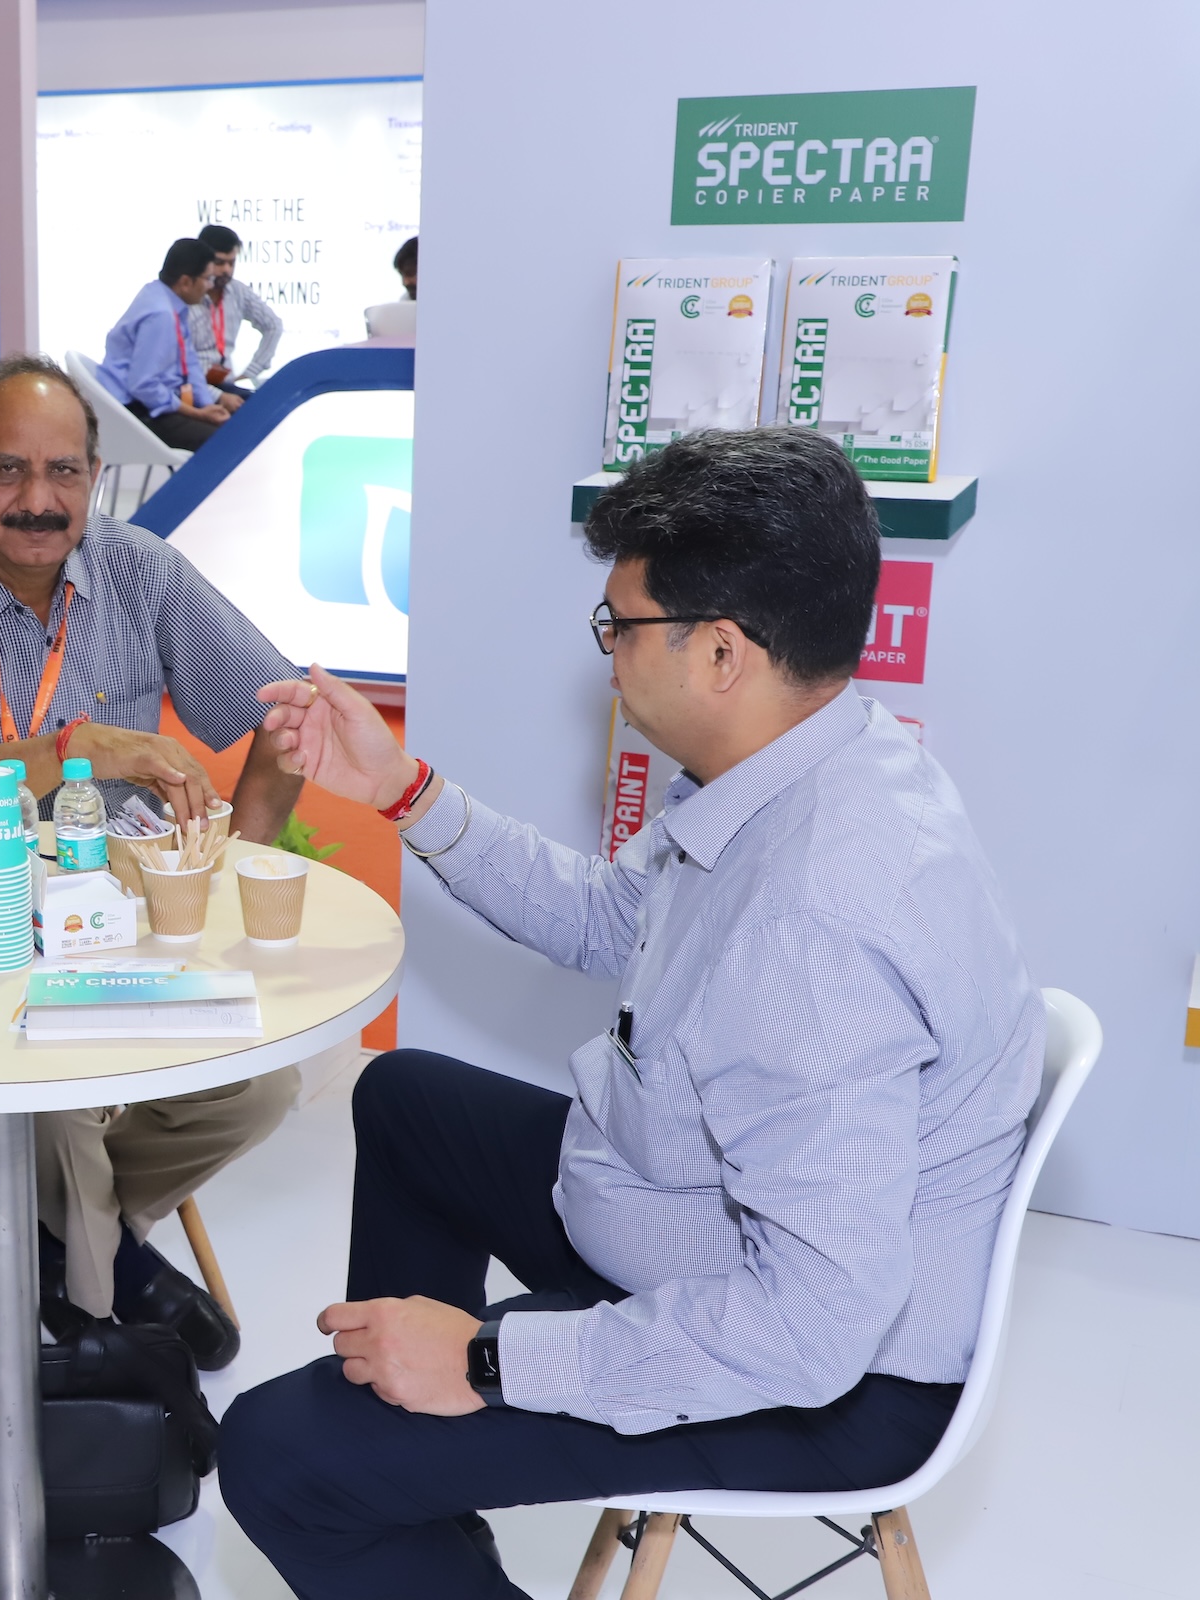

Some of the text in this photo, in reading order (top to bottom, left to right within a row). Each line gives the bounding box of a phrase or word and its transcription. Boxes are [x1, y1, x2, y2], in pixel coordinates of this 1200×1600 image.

[734, 121, 799, 137] TRIDENT
[695, 136, 935, 187] SPECTRA
[695, 186, 930, 206] COPIER PAPER
[197, 198, 305, 222] WE ARE THE
[238, 240, 323, 264] MISTS OF
[789, 322, 828, 427] ECTRA
[616, 322, 655, 463] SPECTRA
[863, 455, 928, 467] The Good Paper
[860, 650, 906, 665] PAPER
[46, 977, 169, 987] MY CHOICE
